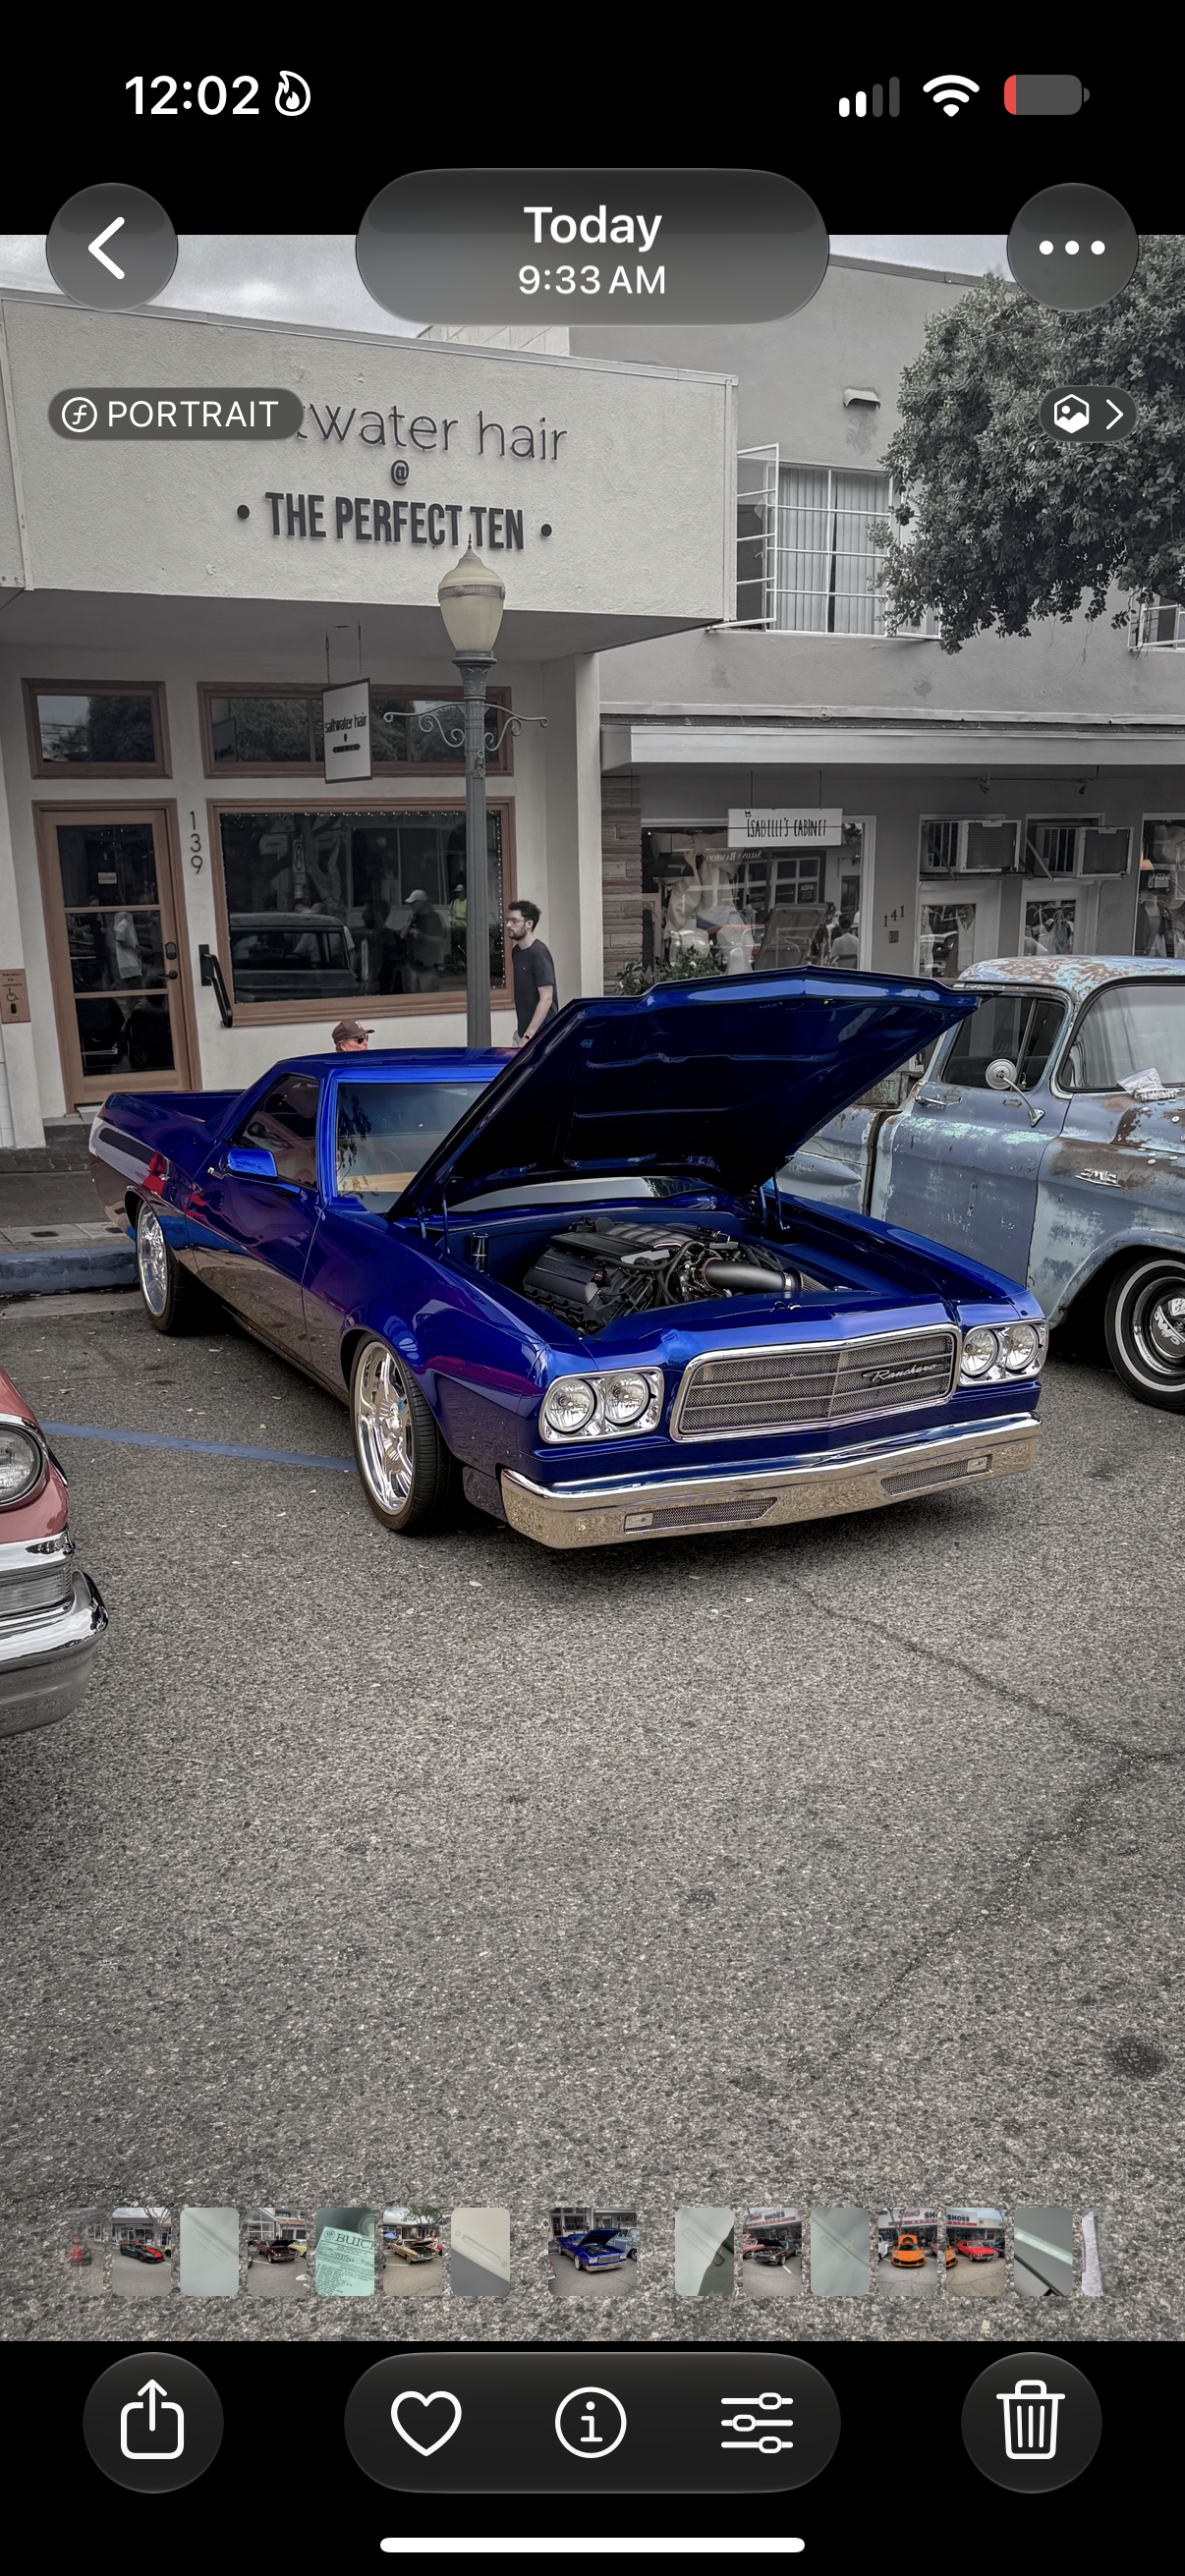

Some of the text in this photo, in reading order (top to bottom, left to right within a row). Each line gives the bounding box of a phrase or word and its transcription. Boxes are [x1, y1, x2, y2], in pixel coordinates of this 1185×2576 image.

[297, 403, 568, 461] water hair
[391, 459, 410, 486] @
[264, 491, 525, 550] THE PERFECT TEN
[324, 711, 367, 733] saltwater hair
[793, 819, 826, 837] CABINET
[883, 905, 904, 927] 141
[863, 1364, 942, 1382] Ranchero
[764, 2212, 785, 2220] SHOES
[946, 2213, 970, 2222] SHOES
